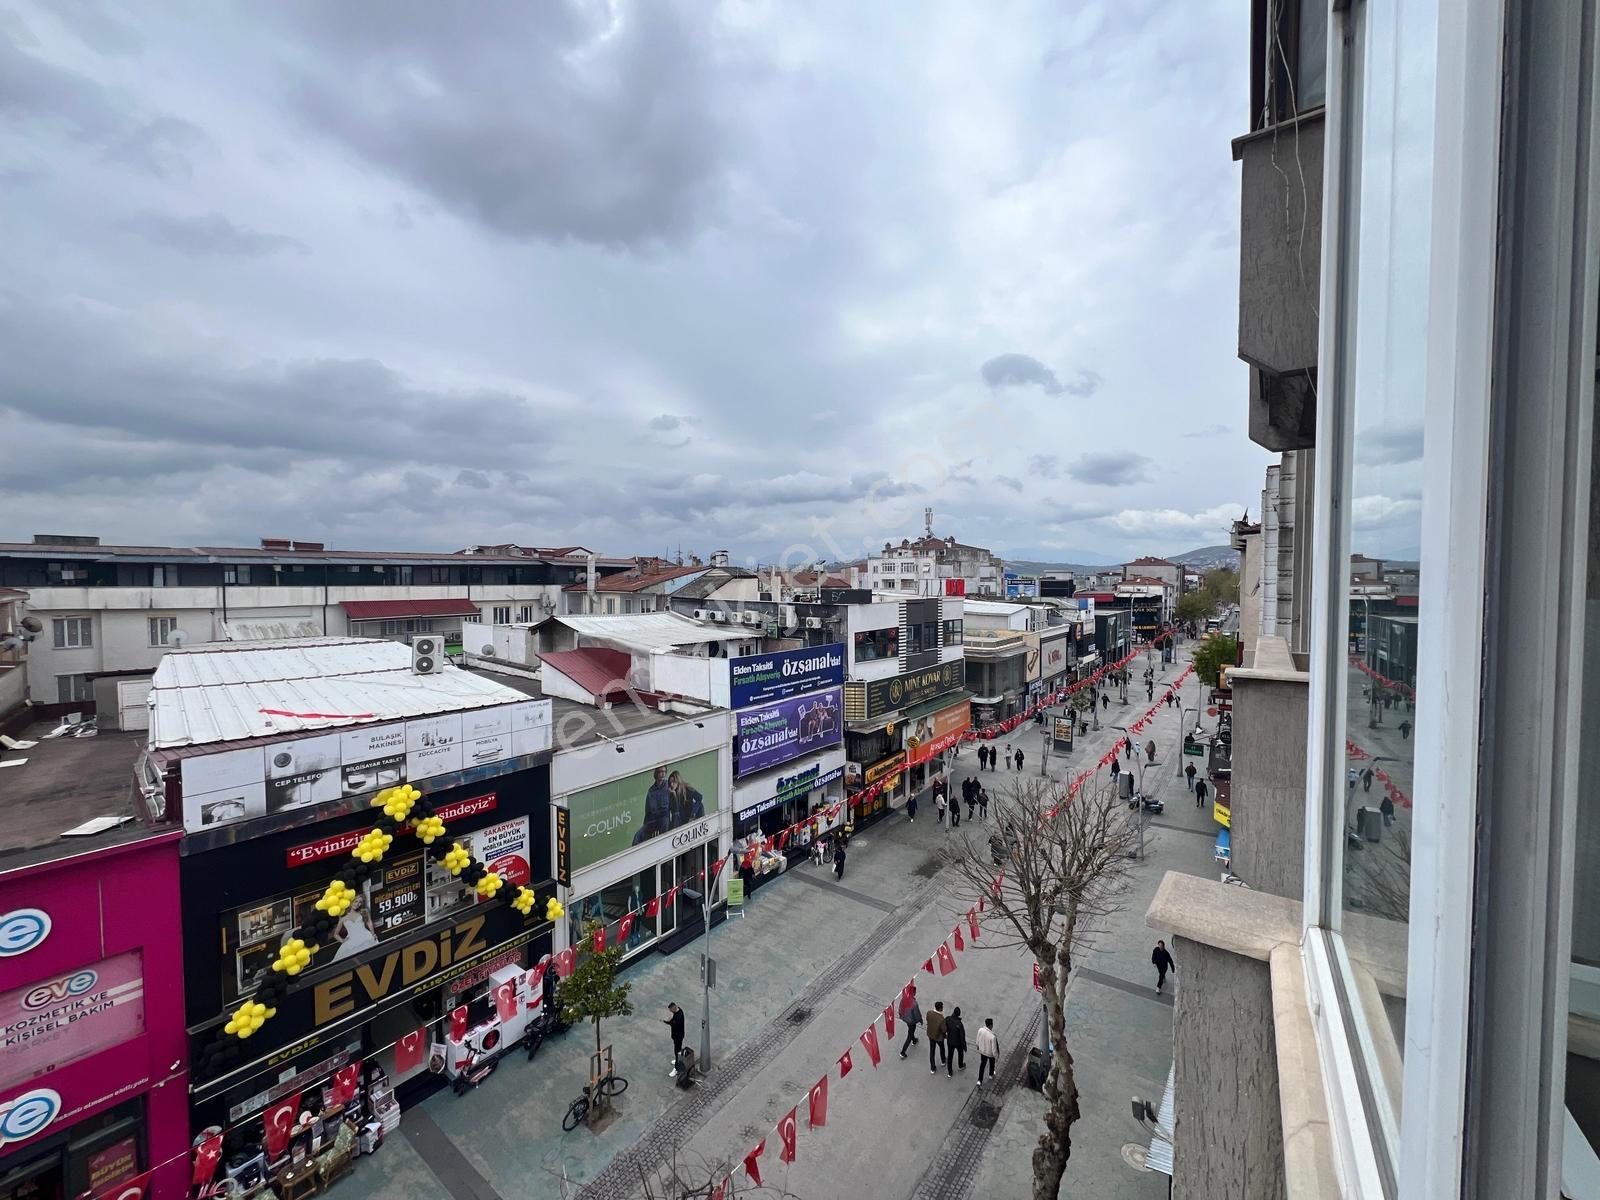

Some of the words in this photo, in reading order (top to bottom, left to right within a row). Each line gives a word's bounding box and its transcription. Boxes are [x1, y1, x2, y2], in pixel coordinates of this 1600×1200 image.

[733, 664, 752, 676] Elden
[740, 716, 760, 727] Elden
[274, 778, 291, 788] CEP
[587, 810, 633, 837] COLIN'S
[488, 836, 498, 844] EN
[498, 827, 522, 841] BÜYÜK
[672, 822, 709, 849] COLIN'S
[385, 913, 403, 928] 16
[23, 970, 98, 1011] eve
[5, 997, 85, 1035] KOZMETİK
[88, 991, 109, 1007] VE
[5, 1020, 65, 1047] KİŞİSEL
[68, 999, 115, 1024] BAKIM
